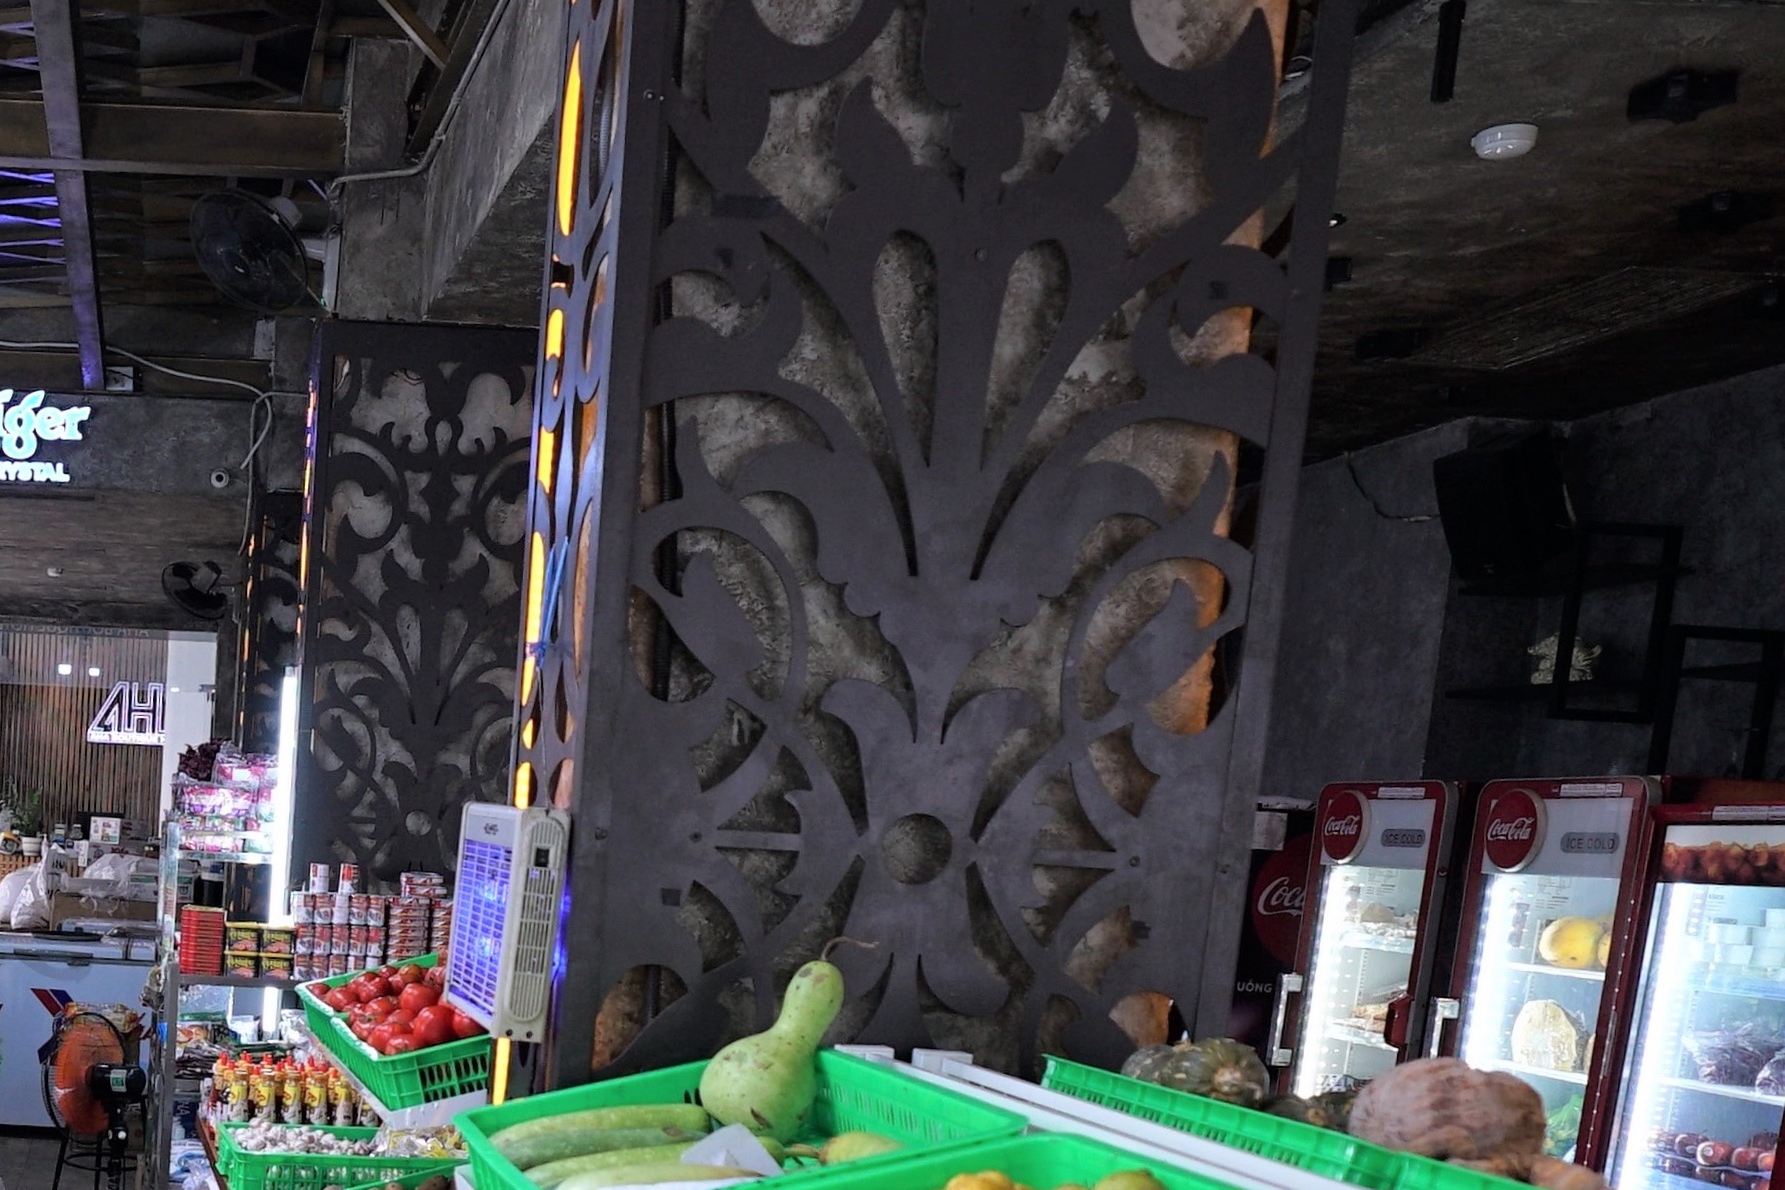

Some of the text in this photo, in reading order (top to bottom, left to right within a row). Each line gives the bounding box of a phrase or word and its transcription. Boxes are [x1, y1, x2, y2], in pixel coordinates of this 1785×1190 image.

[1401, 832, 1423, 845] COLD
[1565, 836, 1585, 849] ICE
[1587, 837, 1615, 850] COLD
[1236, 978, 1273, 994] UỐNG
